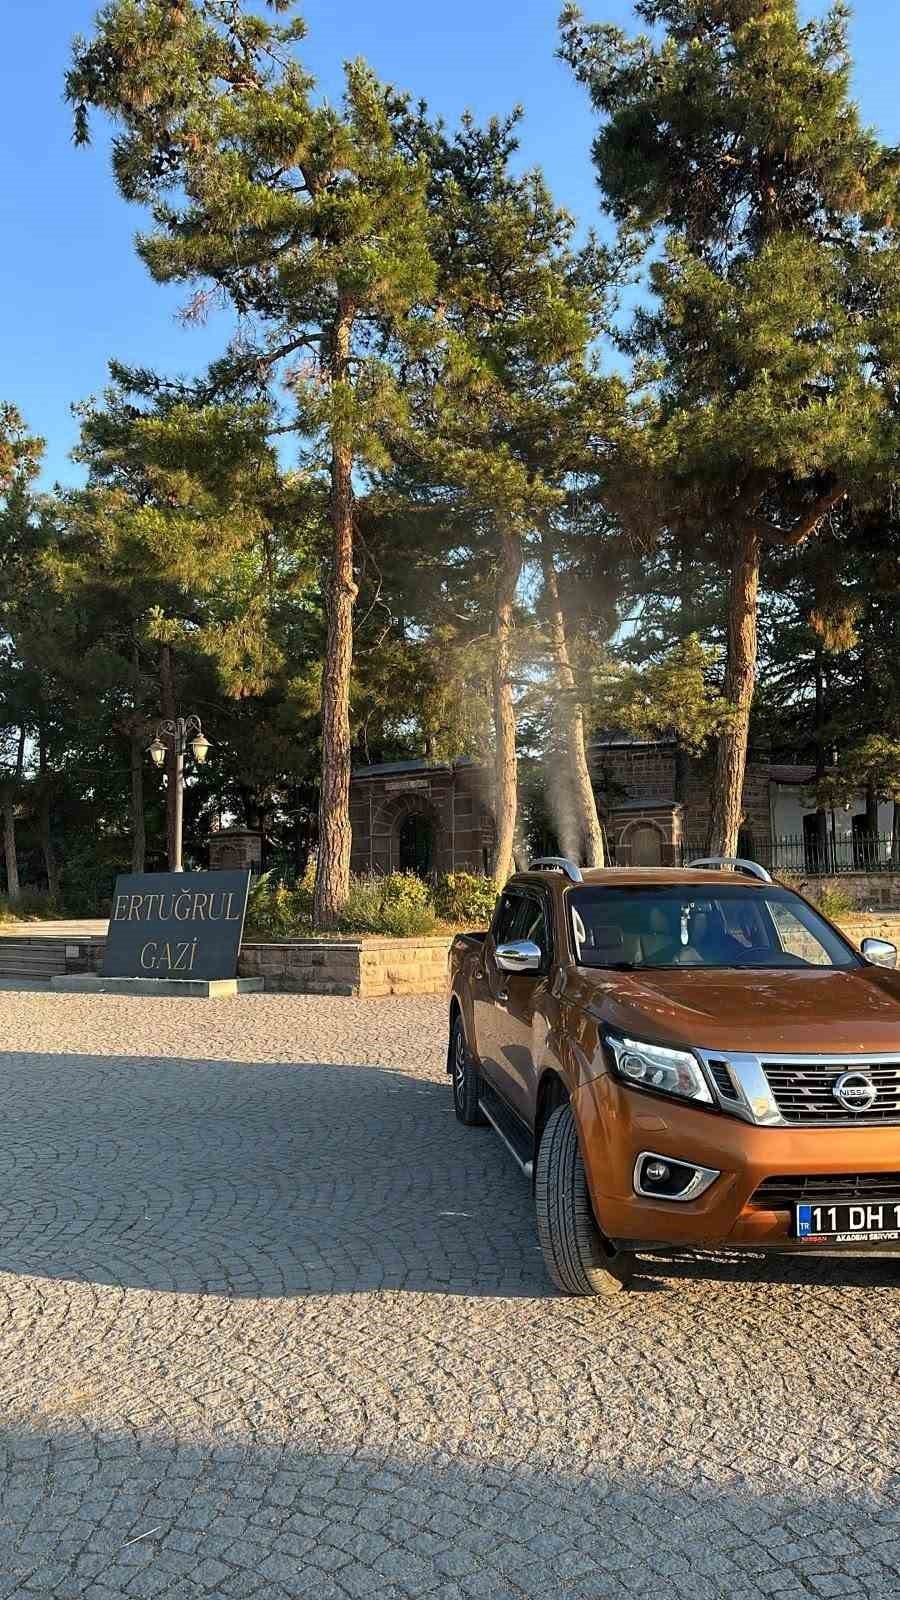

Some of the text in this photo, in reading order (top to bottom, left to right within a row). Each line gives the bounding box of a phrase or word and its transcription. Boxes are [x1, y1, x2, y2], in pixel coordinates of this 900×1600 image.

[114, 888, 240, 921] ERTUĞRUL
[140, 936, 199, 970] GAZİ
[800, 1222, 810, 1231] TR
[813, 1207, 837, 1231] 11
[849, 1206, 883, 1230] DH
[869, 1232, 898, 1240] SERVICE
